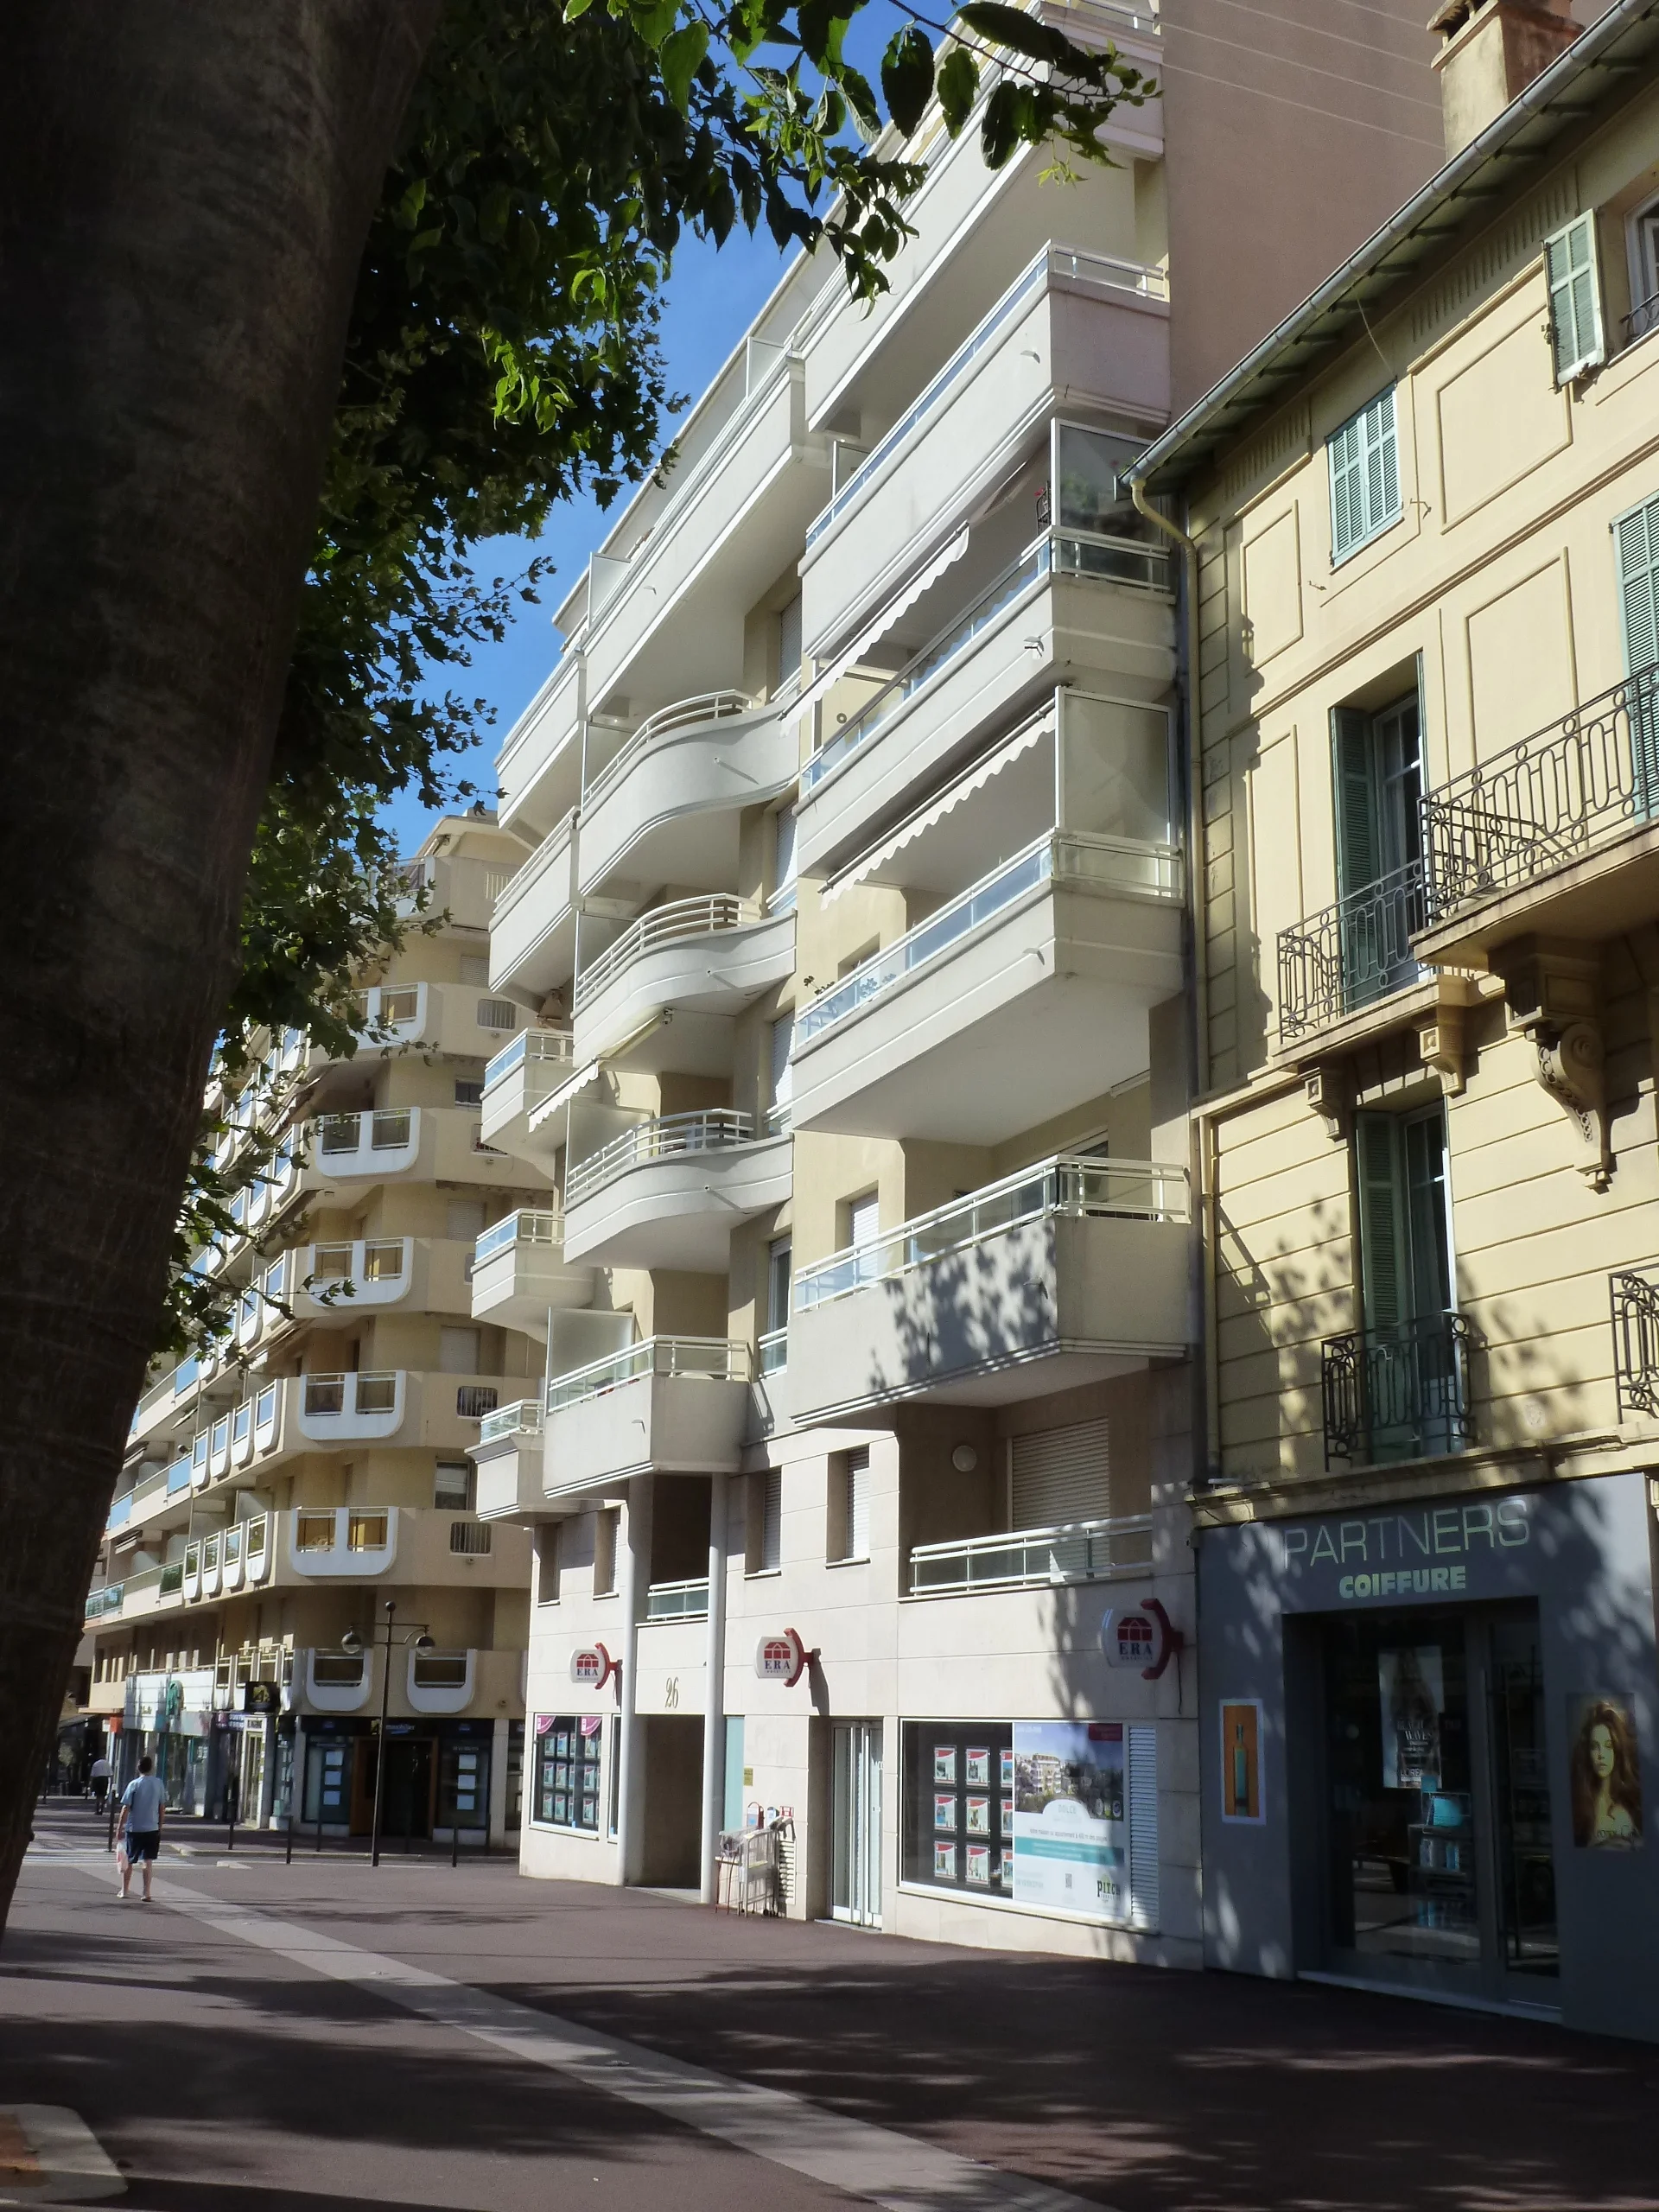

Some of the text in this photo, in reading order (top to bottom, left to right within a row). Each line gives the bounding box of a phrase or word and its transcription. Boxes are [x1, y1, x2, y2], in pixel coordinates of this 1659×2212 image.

[1284, 1499, 1529, 1570] PARTNERS
[1338, 1565, 1466, 1599] COIFFURE
[1119, 1642, 1153, 1656] ERA
[576, 1668, 598, 1676] ERA
[765, 1660, 791, 1669] ERA
[664, 1676, 679, 1708] 26
